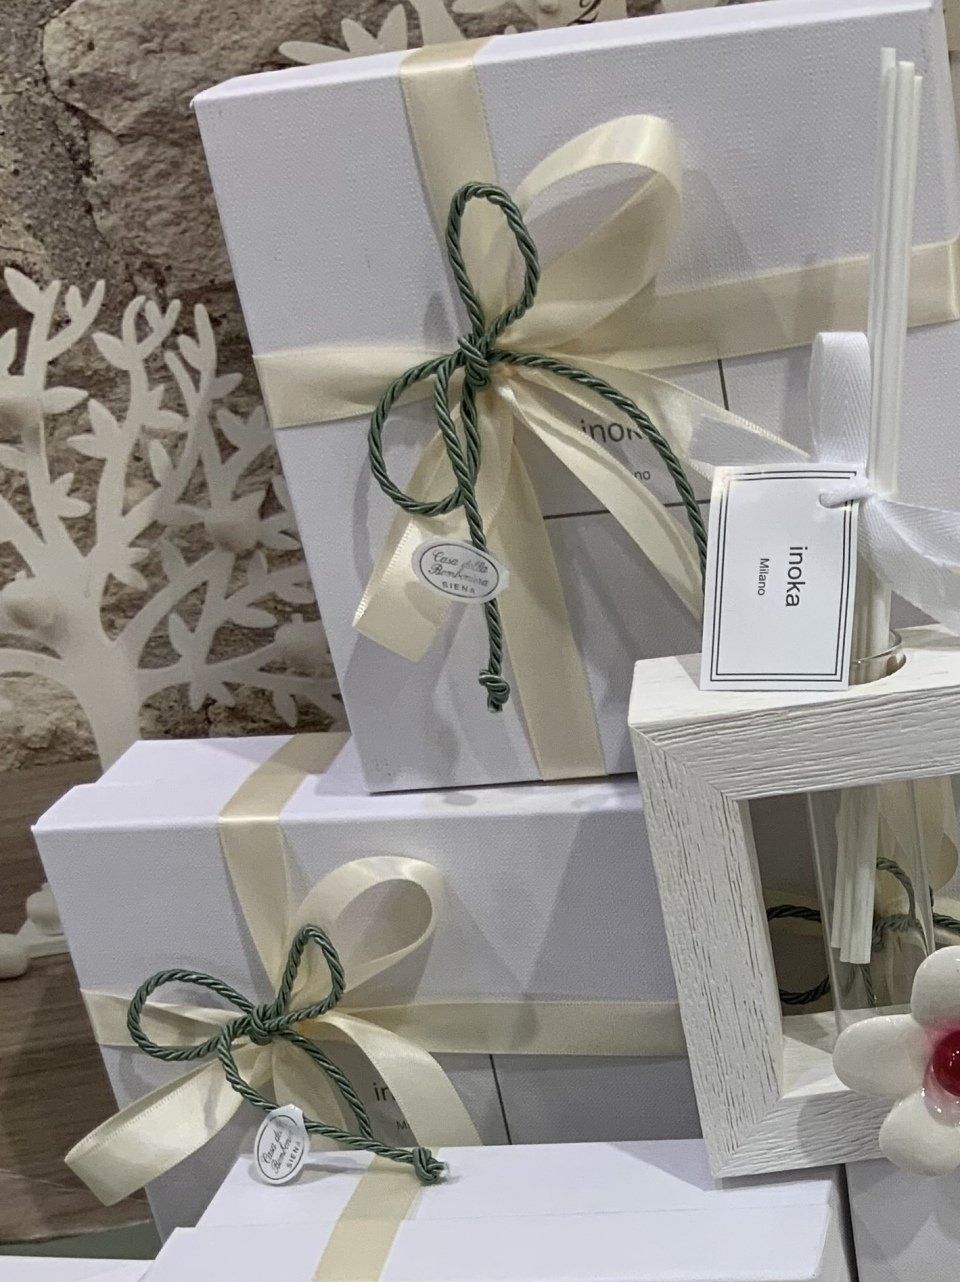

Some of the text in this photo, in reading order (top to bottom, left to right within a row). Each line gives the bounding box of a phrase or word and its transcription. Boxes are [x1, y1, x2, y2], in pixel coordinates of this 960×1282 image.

[441, 581, 476, 594] SIENA
[757, 558, 770, 596] Milano
[785, 546, 809, 608] inoka
